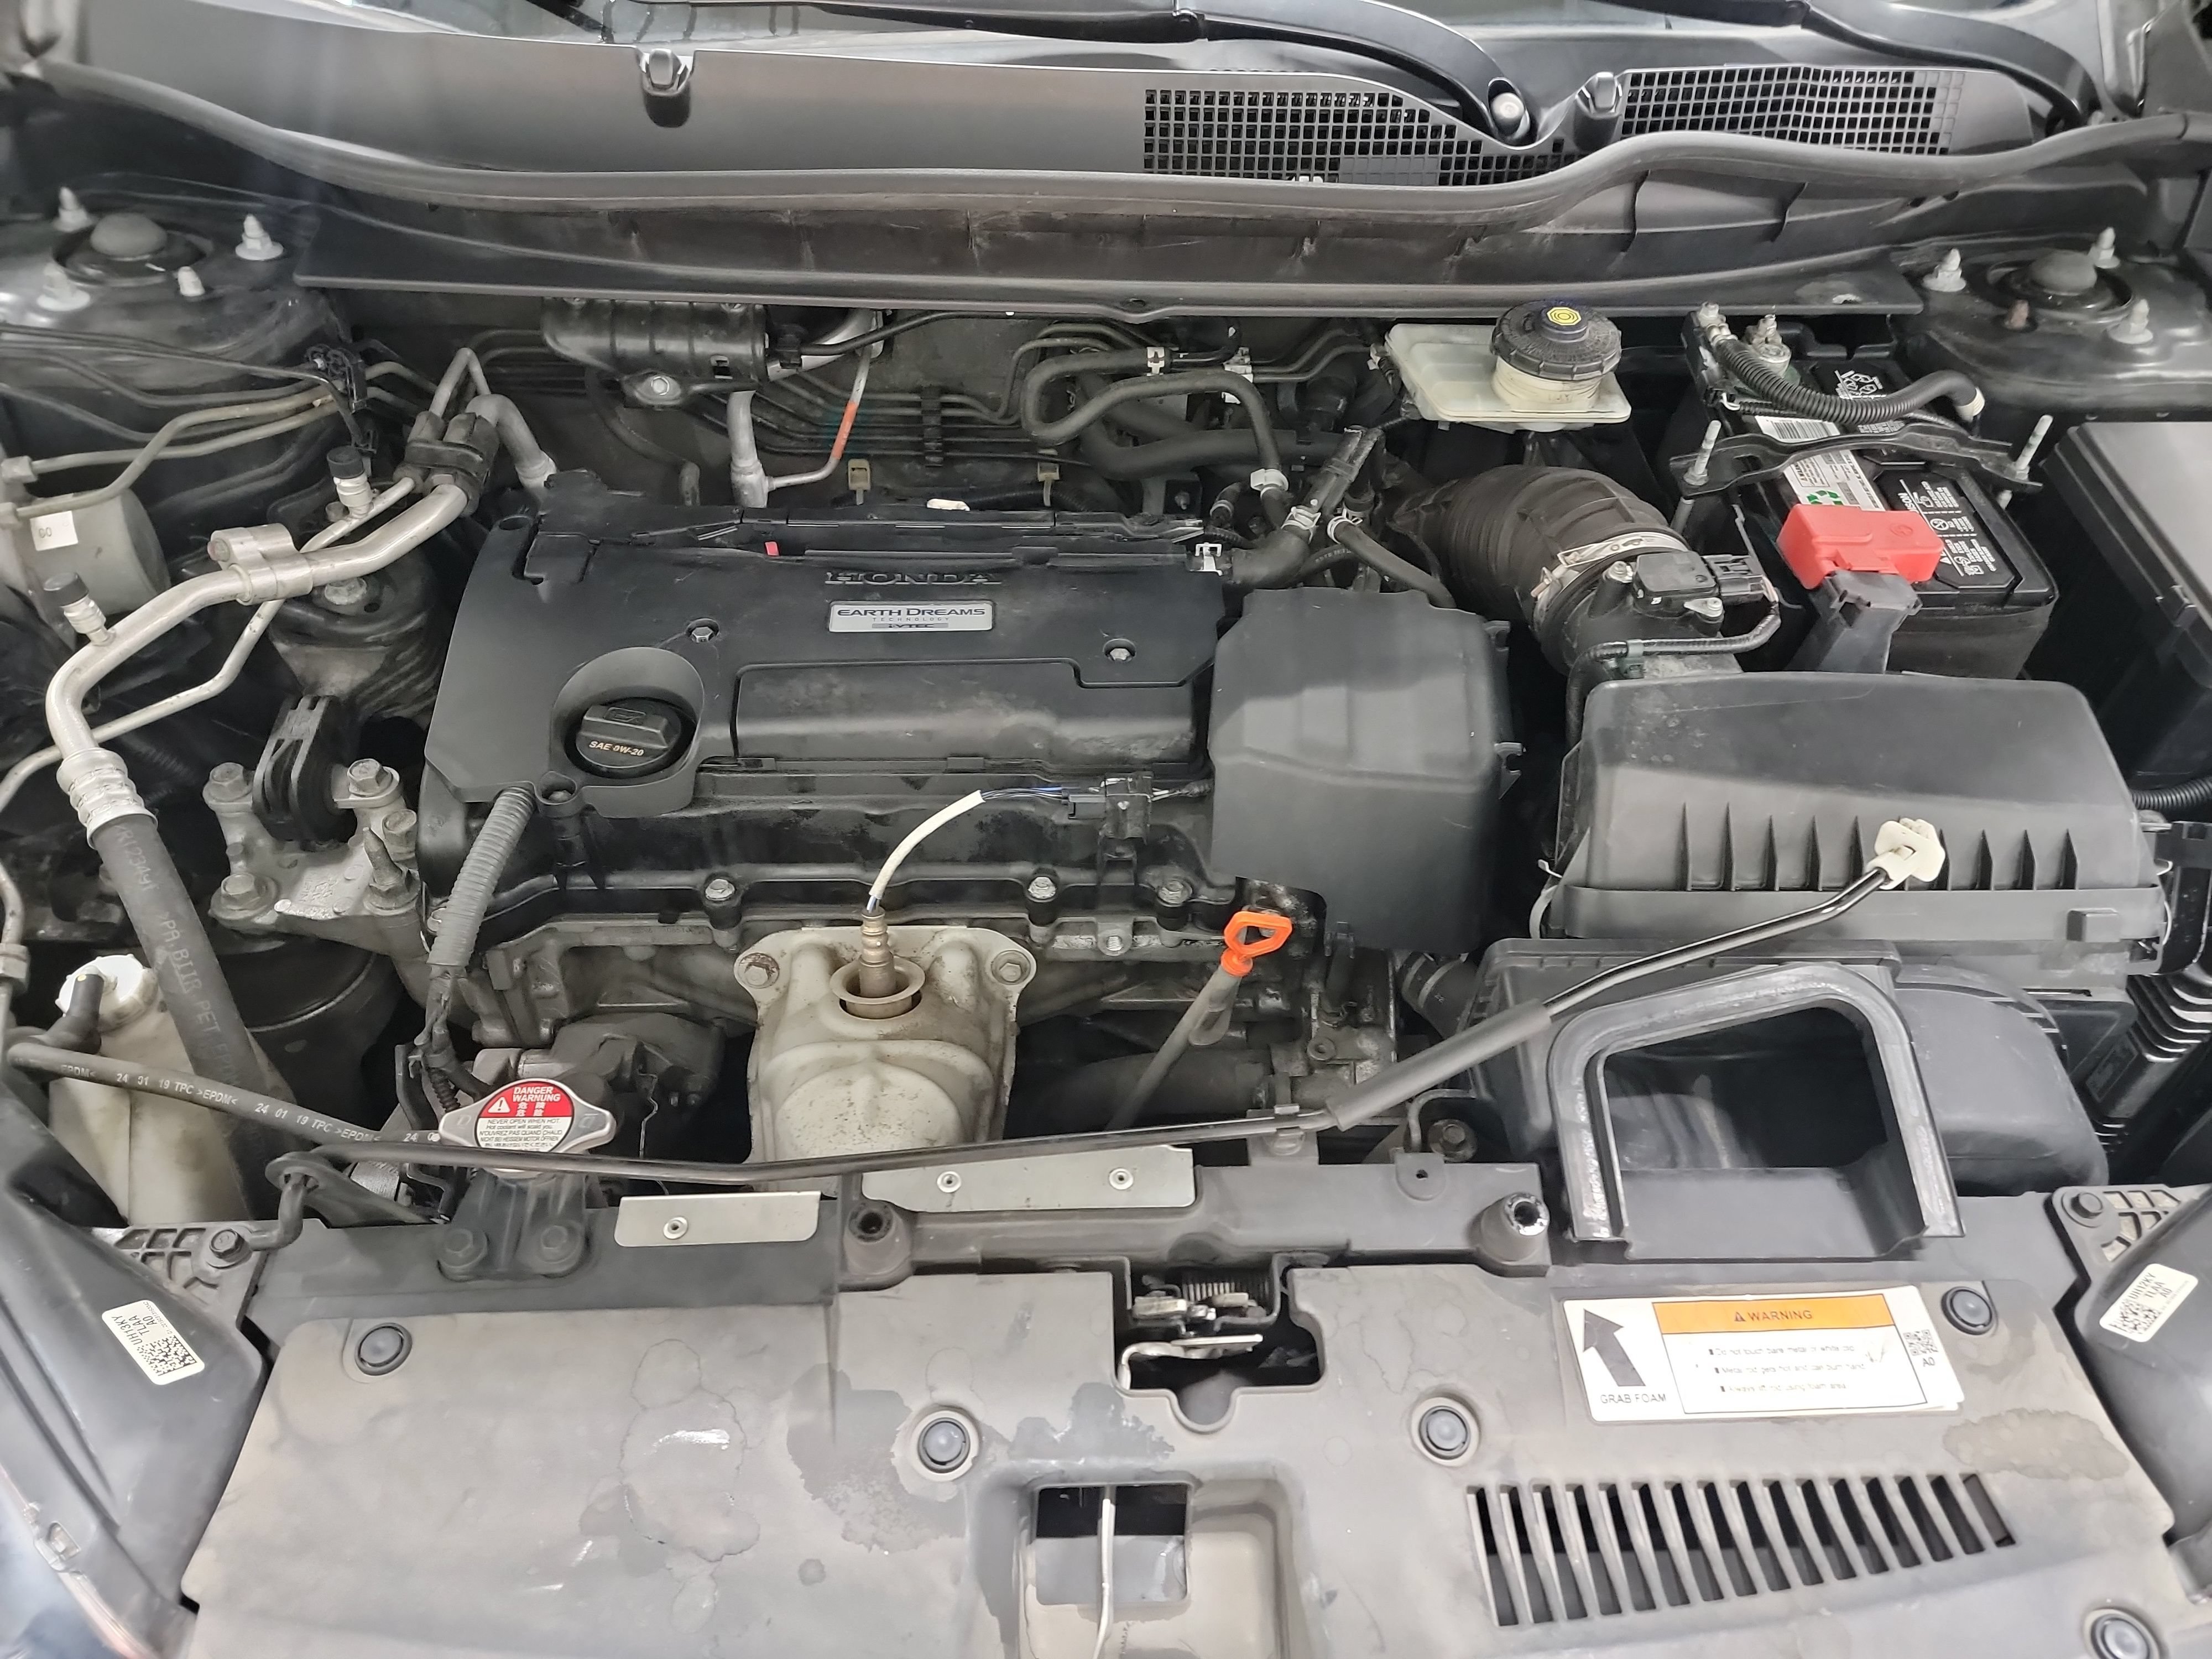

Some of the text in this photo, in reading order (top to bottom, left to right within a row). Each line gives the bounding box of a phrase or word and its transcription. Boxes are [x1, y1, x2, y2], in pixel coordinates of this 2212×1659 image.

[824, 572, 1002, 585] HONDA
[837, 608, 901, 617] EARTH
[589, 742, 644, 757] SAE 0W-20
[513, 1094, 561, 1102] WARNUNG
[116, 1073, 128, 1083] 24
[159, 1079, 170, 1089] 19
[174, 1082, 194, 1094] TPC
[255, 1103, 270, 1114] 24
[275, 1108, 288, 1119] 01
[296, 1114, 309, 1125] 19
[311, 1119, 333, 1133] TPC
[403, 1133, 418, 1142] 24
[1747, 1310, 1813, 1322] WARNING
[111, 1315, 143, 1345] UH13KY
[128, 1315, 150, 1336] TLAA
[1599, 1392, 1667, 1405] GRAB FOAM
